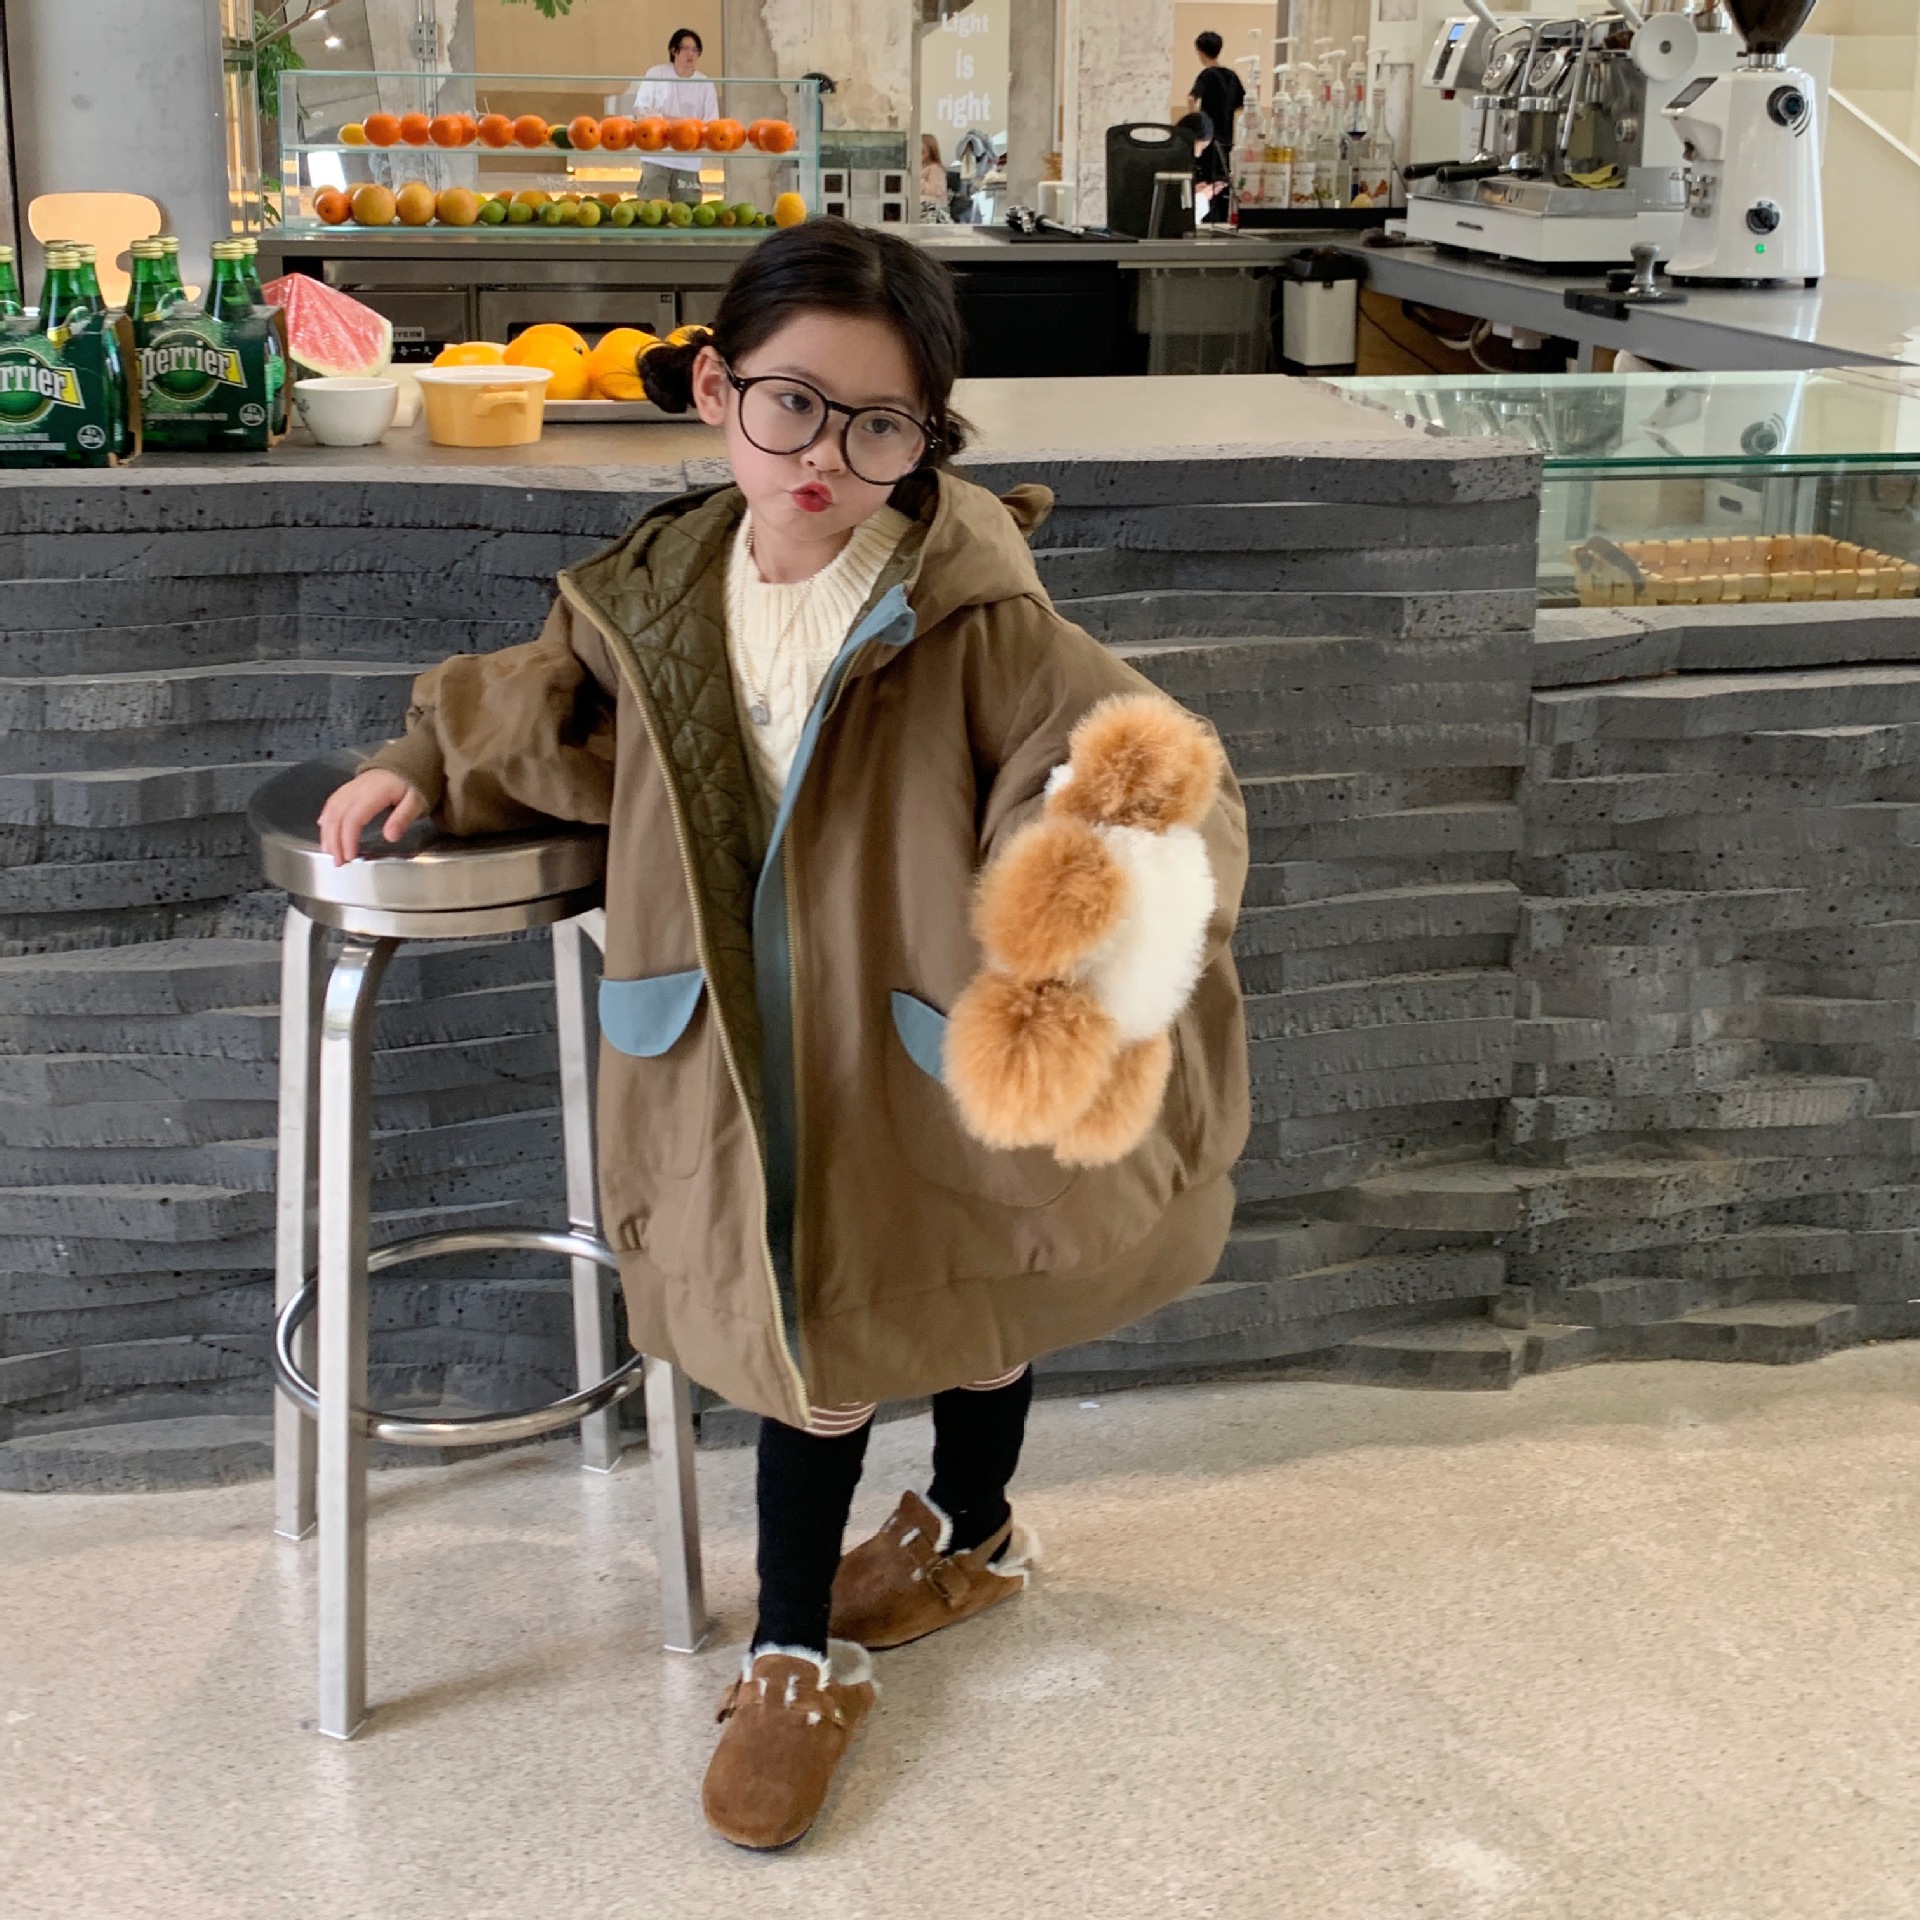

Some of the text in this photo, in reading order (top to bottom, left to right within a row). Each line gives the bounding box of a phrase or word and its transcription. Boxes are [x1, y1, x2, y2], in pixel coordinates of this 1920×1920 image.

[941, 10, 989, 38] Light
[955, 48, 974, 80] is
[937, 90, 991, 128] right
[139, 340, 230, 399] perrier
